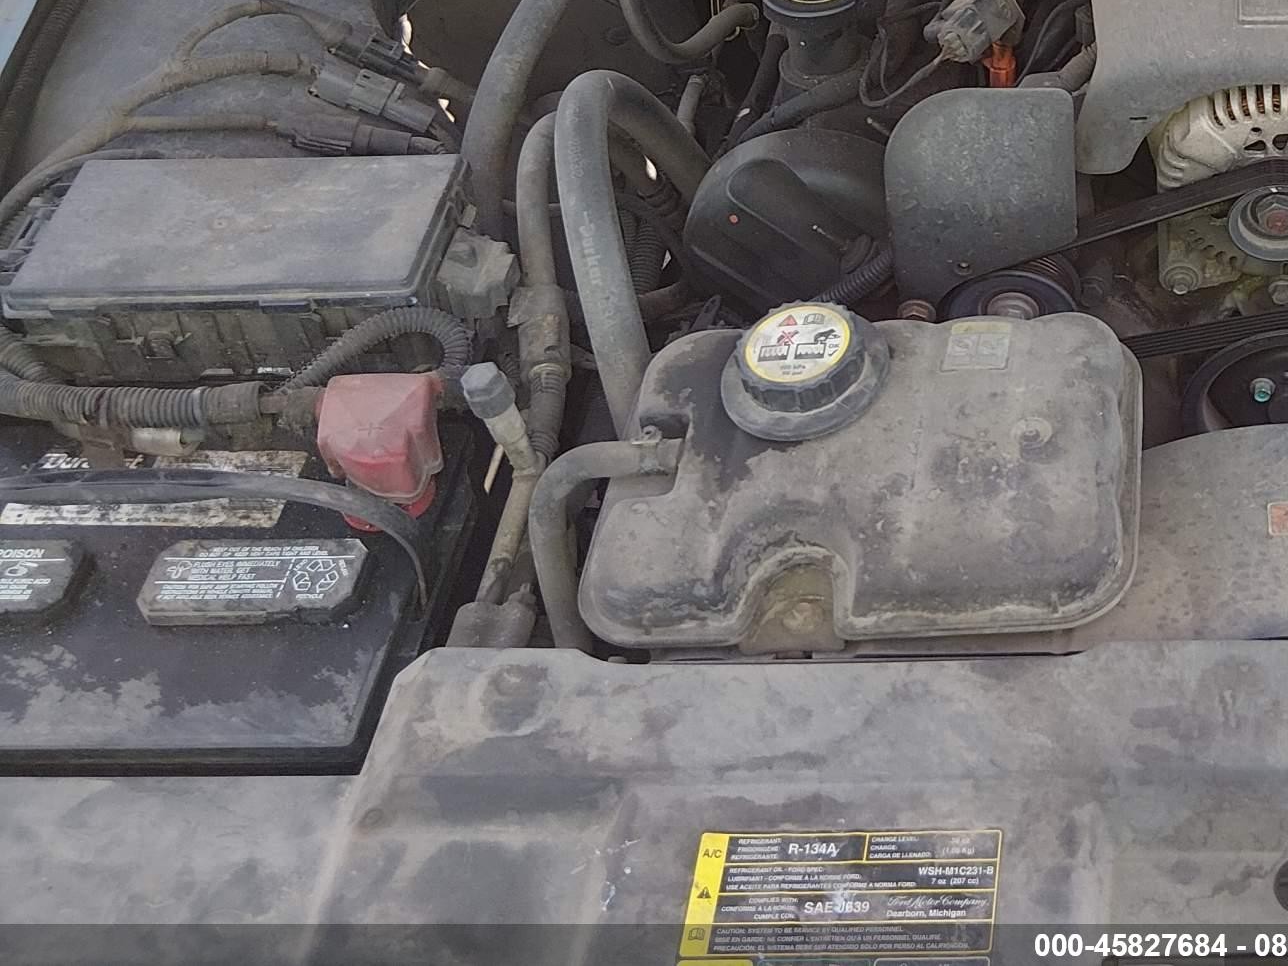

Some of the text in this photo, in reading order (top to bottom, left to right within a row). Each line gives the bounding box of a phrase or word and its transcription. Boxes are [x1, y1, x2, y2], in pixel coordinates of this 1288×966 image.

[702, 848, 722, 859] A/C
[918, 866, 994, 876] WSH-M1C231-B
[804, 901, 833, 914] SAE
[929, 909, 966, 919] Michigan
